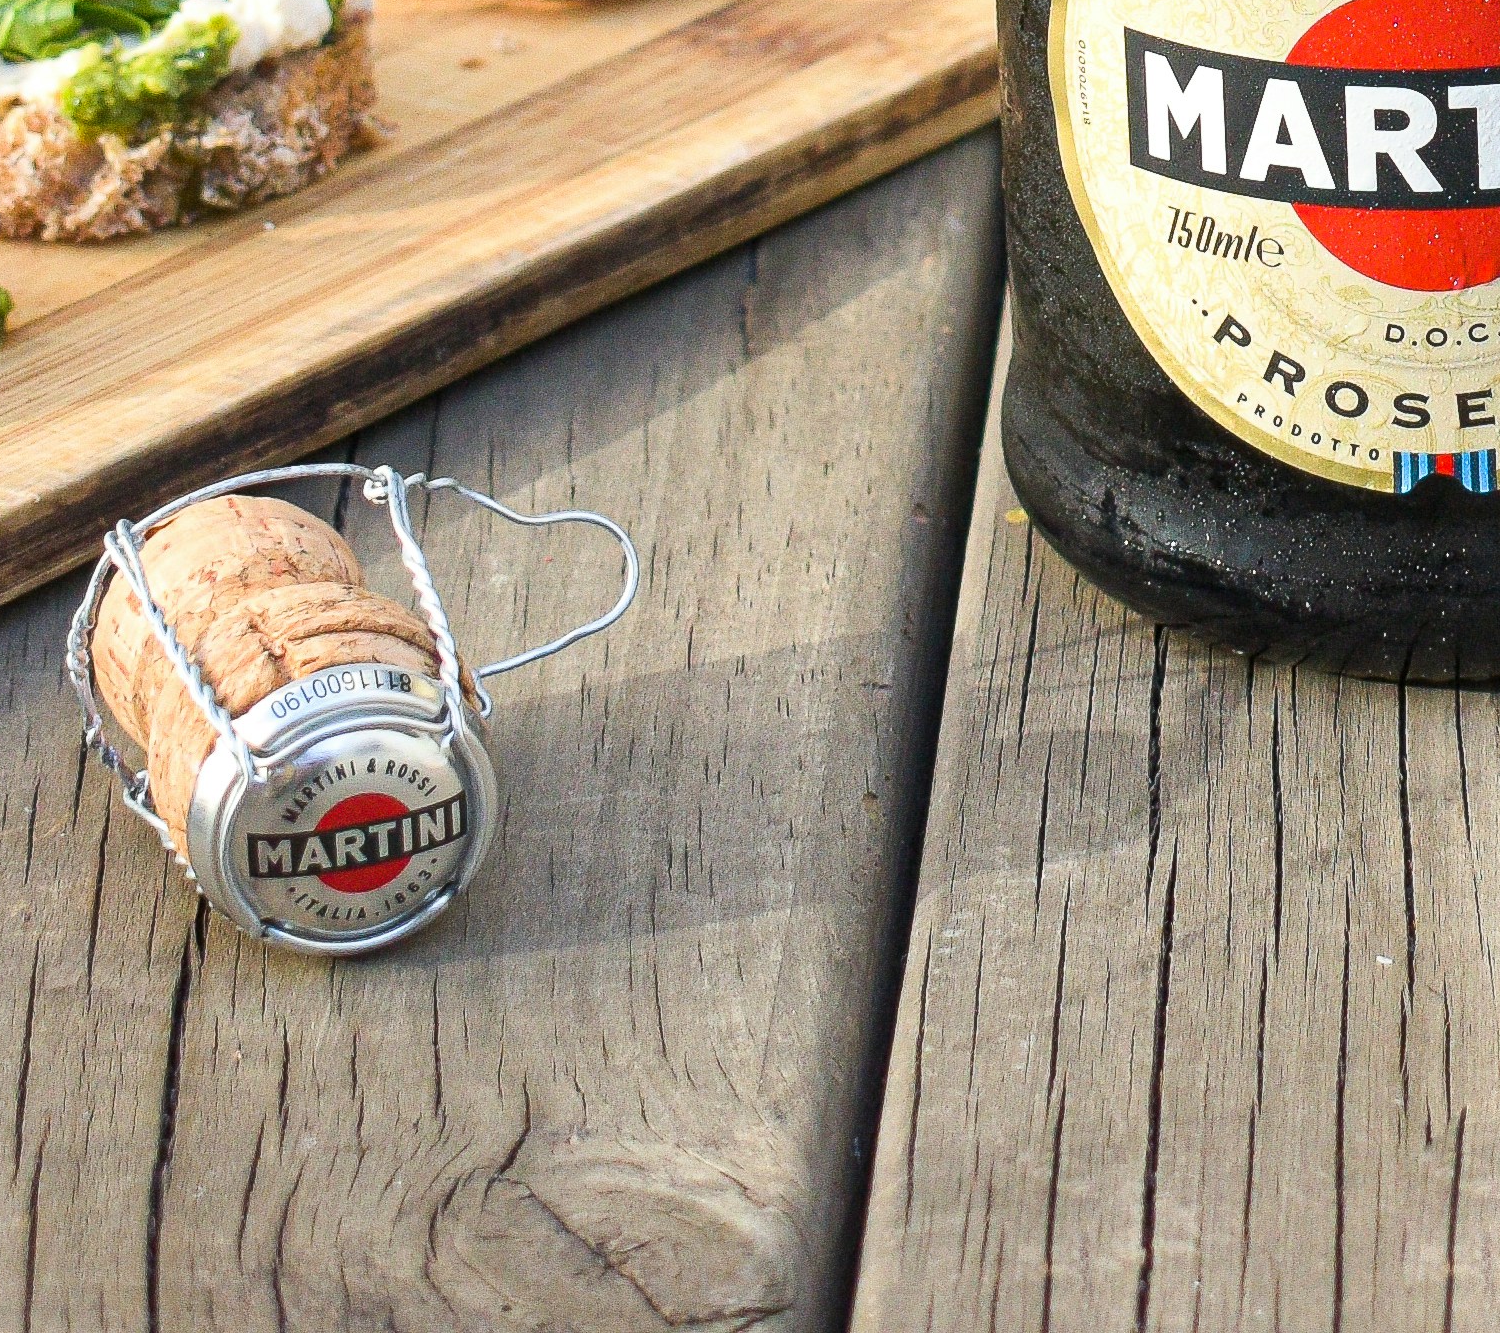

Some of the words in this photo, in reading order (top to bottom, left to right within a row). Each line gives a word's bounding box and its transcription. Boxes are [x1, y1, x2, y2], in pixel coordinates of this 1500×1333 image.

[1236, 391, 1381, 462] PRODOTTO
[270, 669, 412, 719] 8111600190
[281, 759, 358, 824] MARTINI
[385, 758, 438, 798] ROSSI
[256, 799, 462, 874] MARTINI
[294, 892, 367, 921] ITALIA
